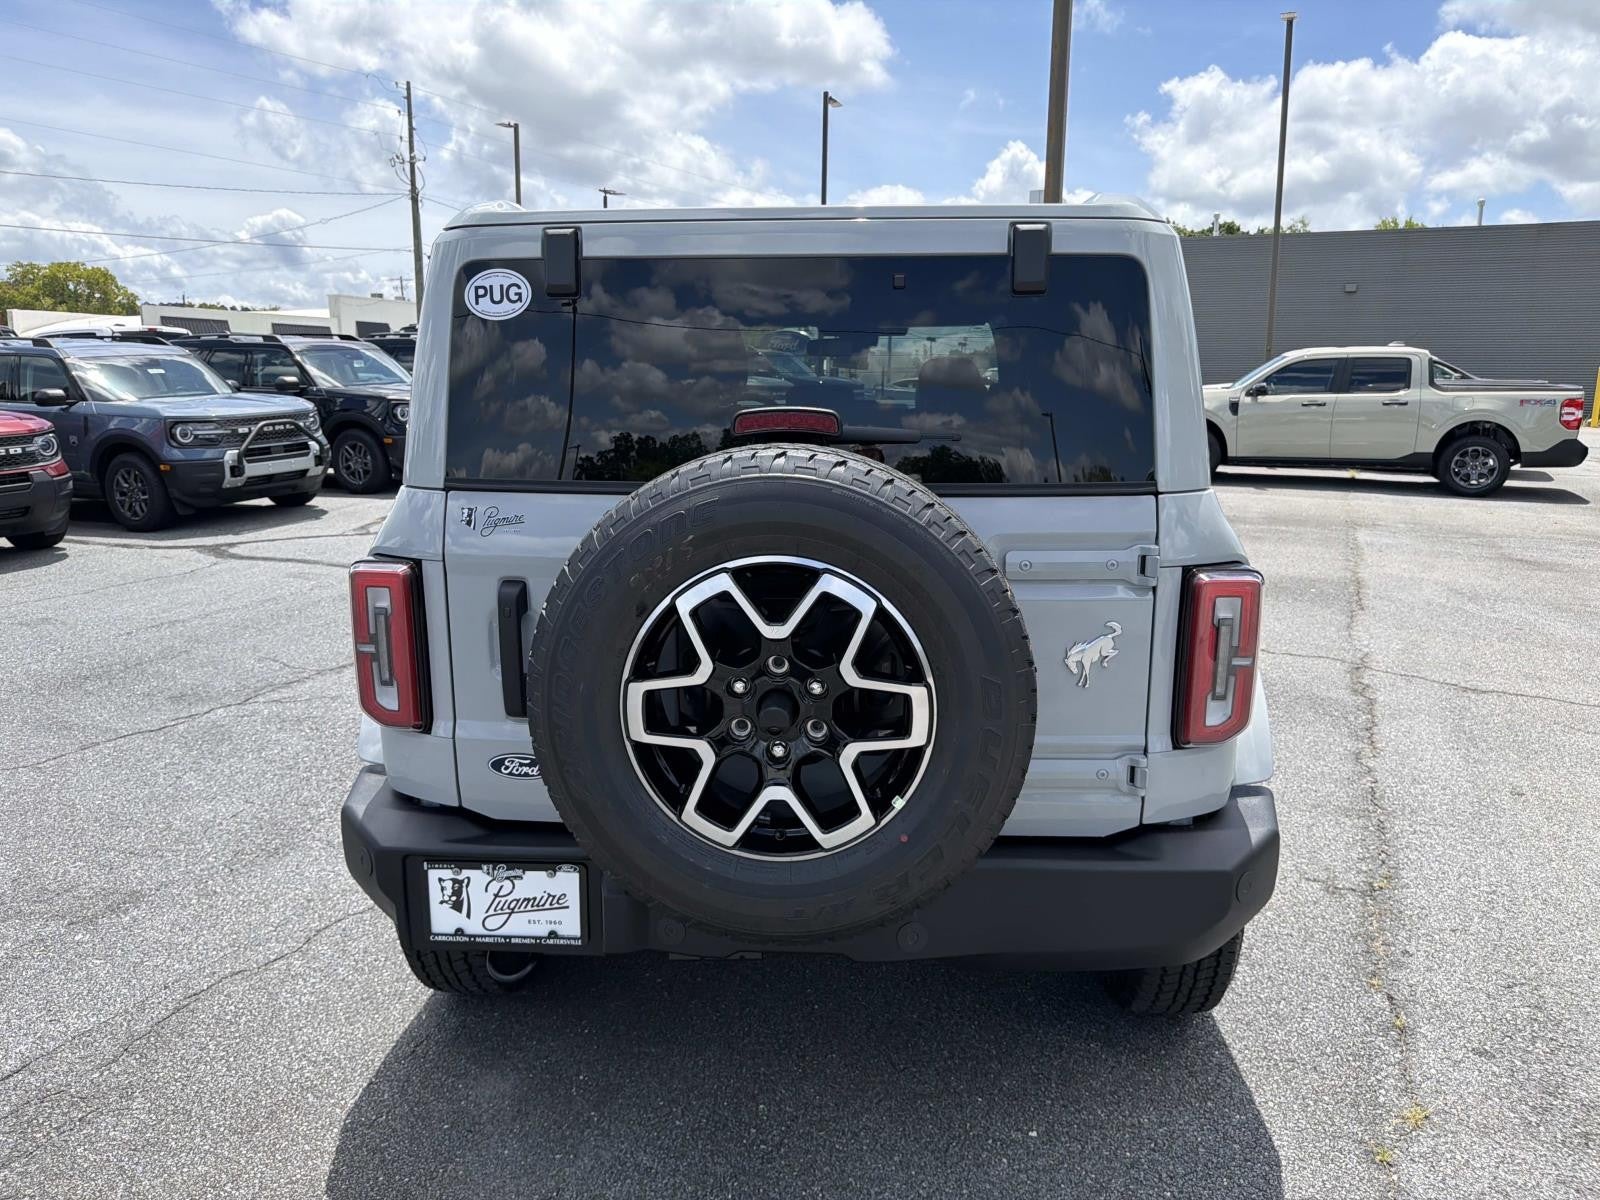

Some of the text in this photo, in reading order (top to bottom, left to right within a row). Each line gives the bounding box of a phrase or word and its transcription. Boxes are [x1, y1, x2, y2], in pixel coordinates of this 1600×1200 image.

[474, 282, 523, 306] PUG
[480, 505, 526, 538] Pugmire
[501, 757, 541, 775] Ford
[481, 878, 570, 932] Pugmire
[545, 918, 563, 926] 1960
[429, 934, 583, 946] CARROLLTON MARIETTA BREMEN CARTERSVILLE
